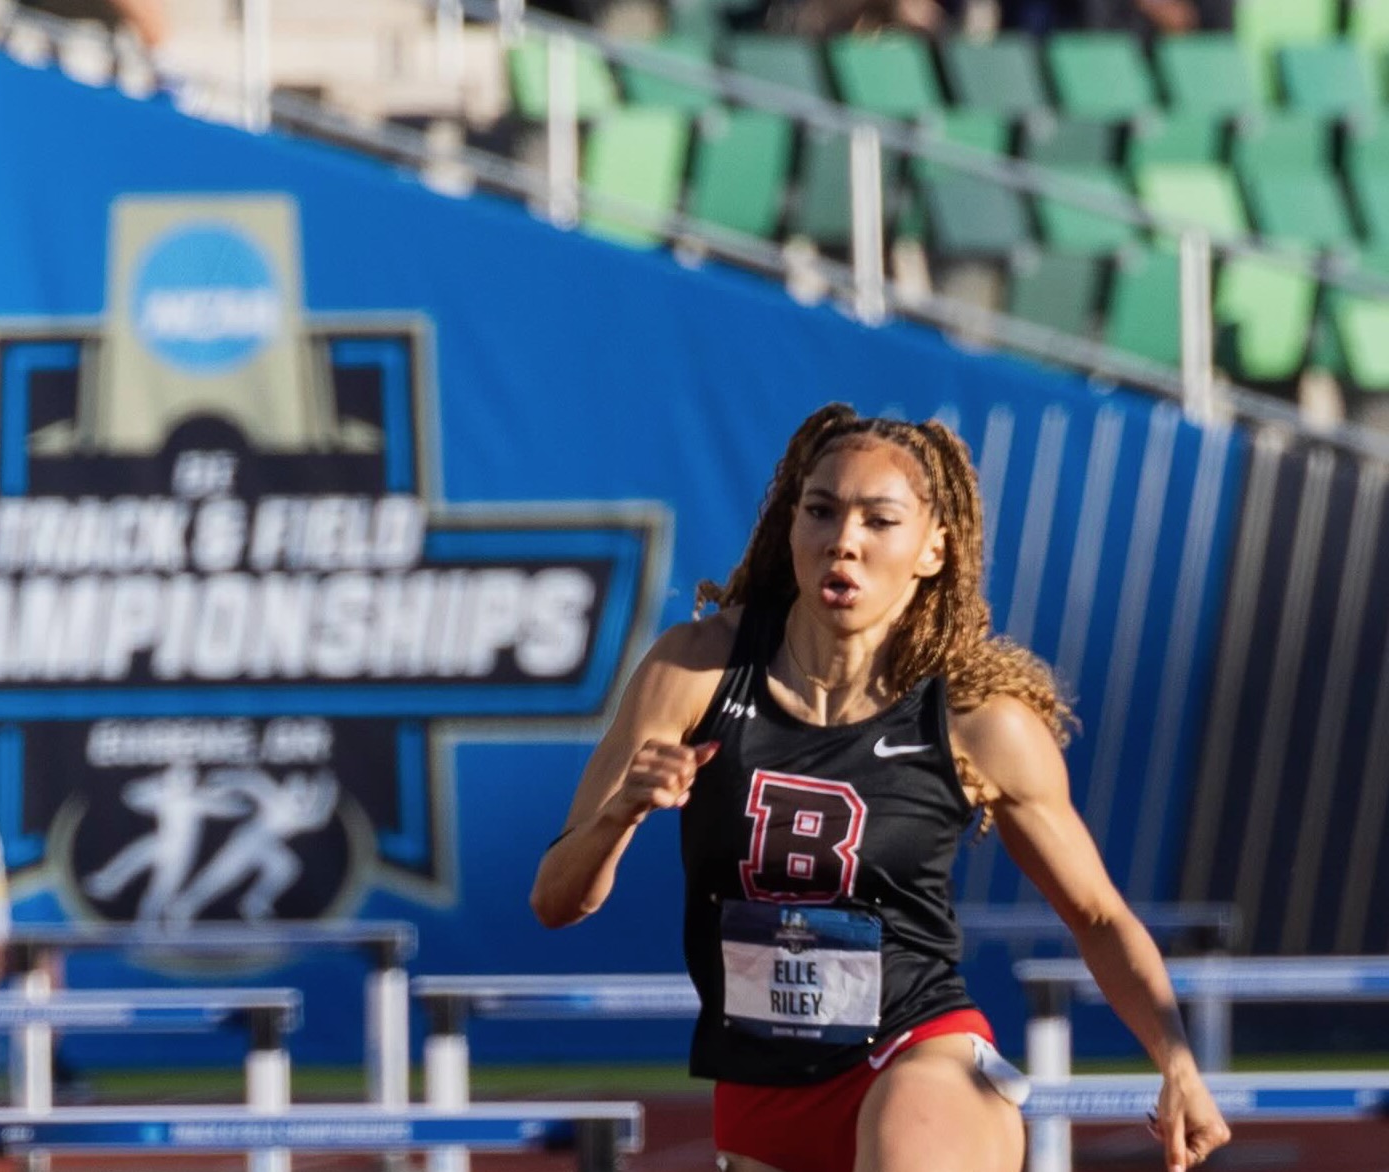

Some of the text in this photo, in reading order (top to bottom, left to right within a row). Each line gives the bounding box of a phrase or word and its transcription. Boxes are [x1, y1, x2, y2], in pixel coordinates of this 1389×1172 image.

[190, 498, 248, 572] &
[250, 496, 423, 571] FIELD
[739, 768, 868, 904] B
[774, 960, 818, 985] ELLE
[771, 986, 823, 1016] RILEY
